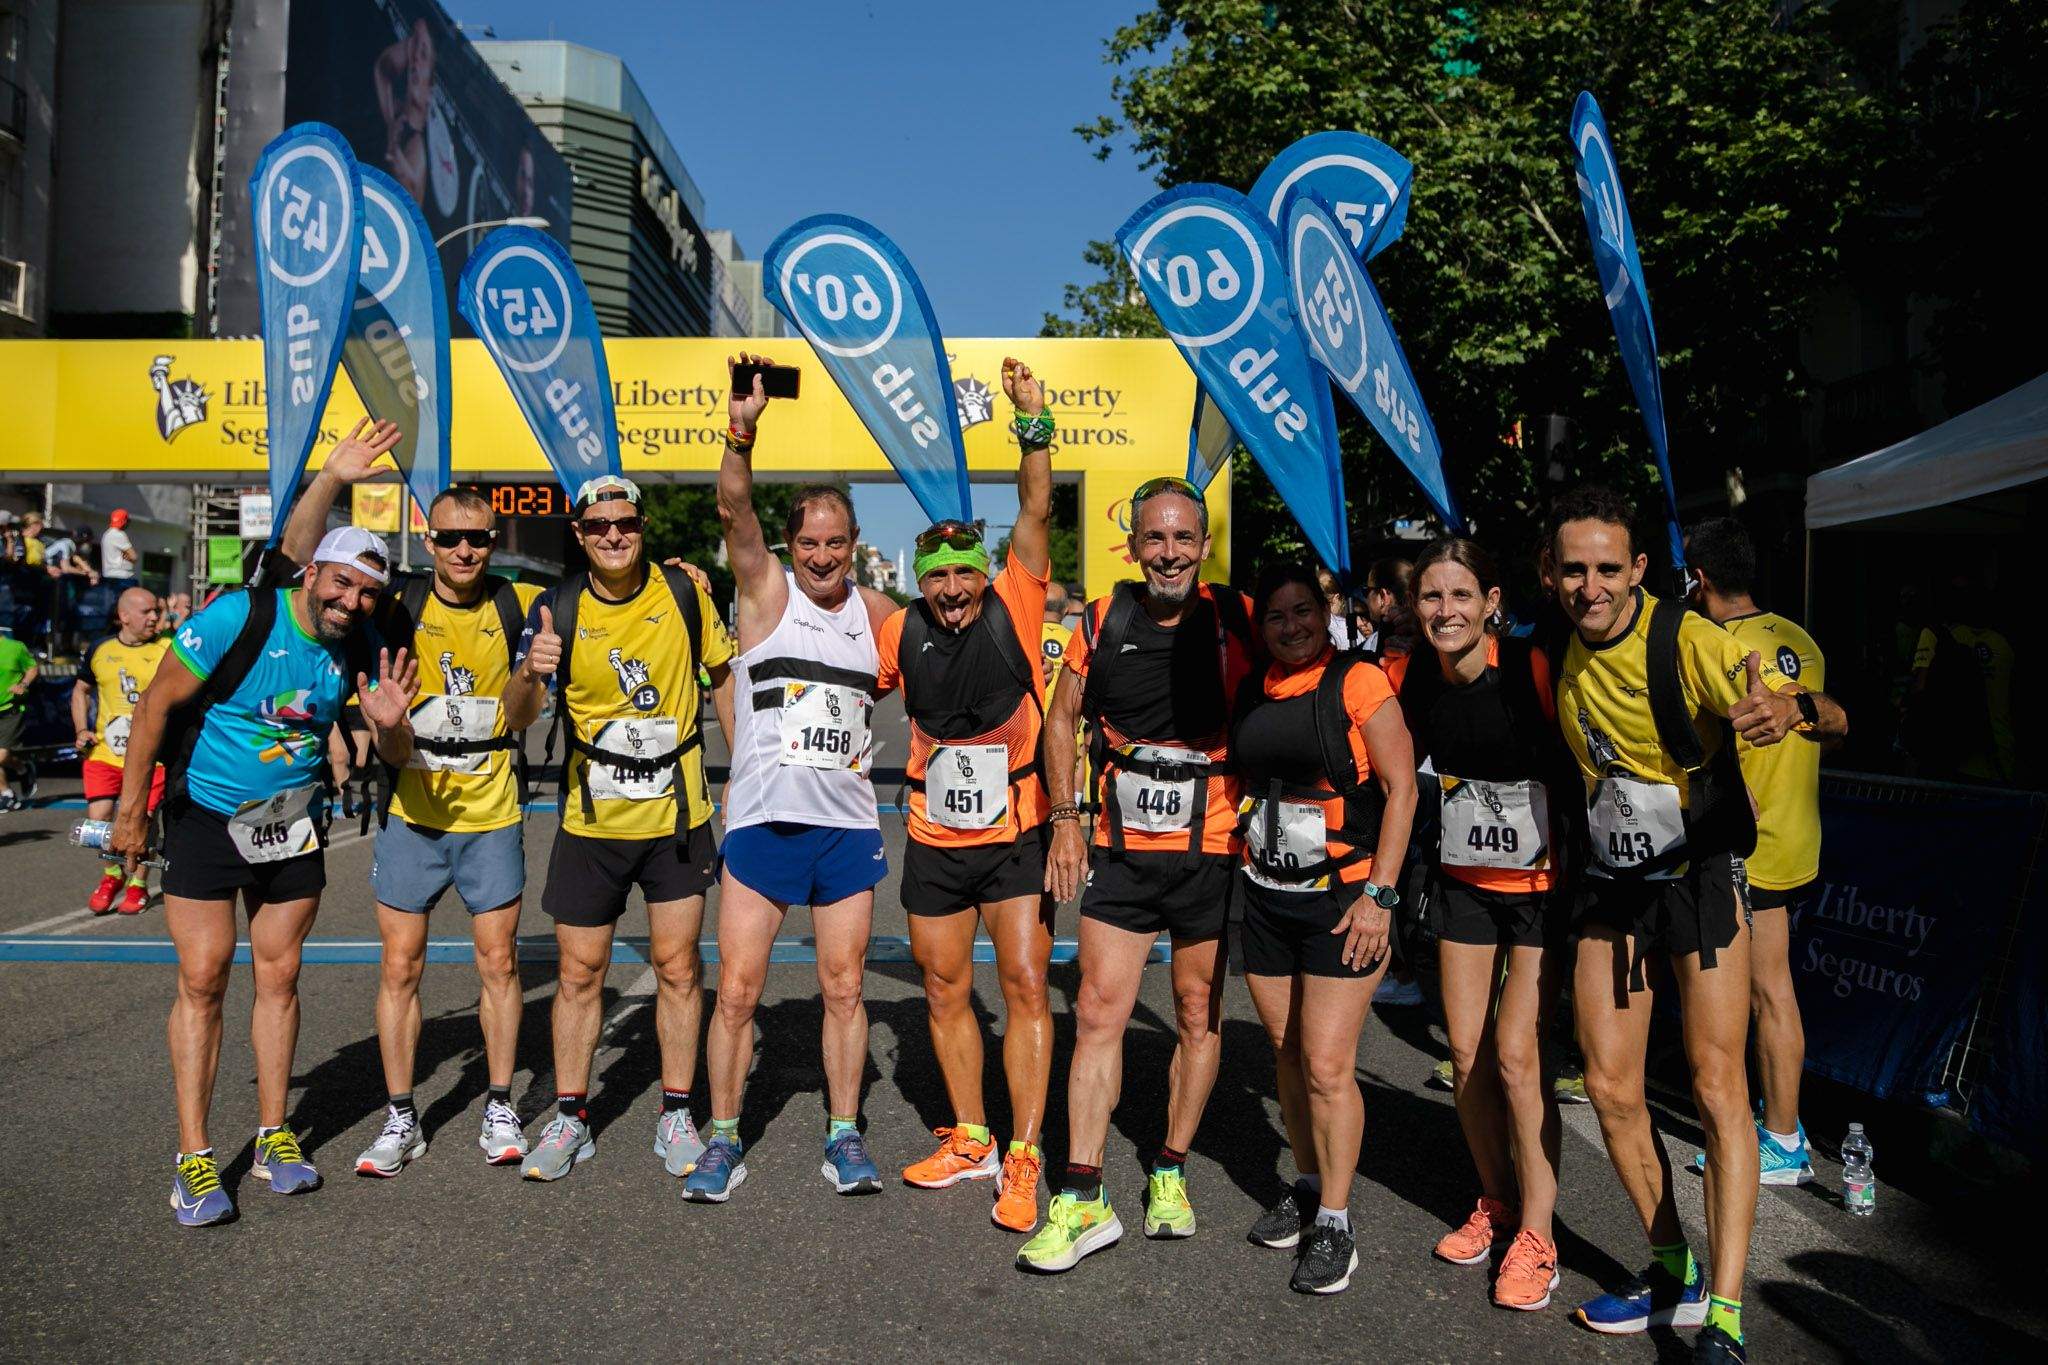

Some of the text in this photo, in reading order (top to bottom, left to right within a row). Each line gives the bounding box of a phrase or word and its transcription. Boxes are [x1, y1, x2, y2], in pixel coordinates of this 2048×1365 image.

[615, 380, 724, 417] Liberty
[1040, 379, 1122, 418] berty
[221, 419, 339, 455] Segos
[1047, 642, 1060, 655] 13
[1780, 654, 1797, 674] 13
[637, 690, 655, 706] 13
[801, 726, 851, 755] 1458
[612, 765, 655, 784] 444
[945, 789, 983, 813] 451
[1137, 788, 1181, 816] 448
[251, 820, 289, 849] 445
[1467, 825, 1519, 854] 449
[1608, 832, 1655, 862] 443
[1815, 882, 1938, 956] Liberty
[1802, 937, 1926, 1002] Seguros
